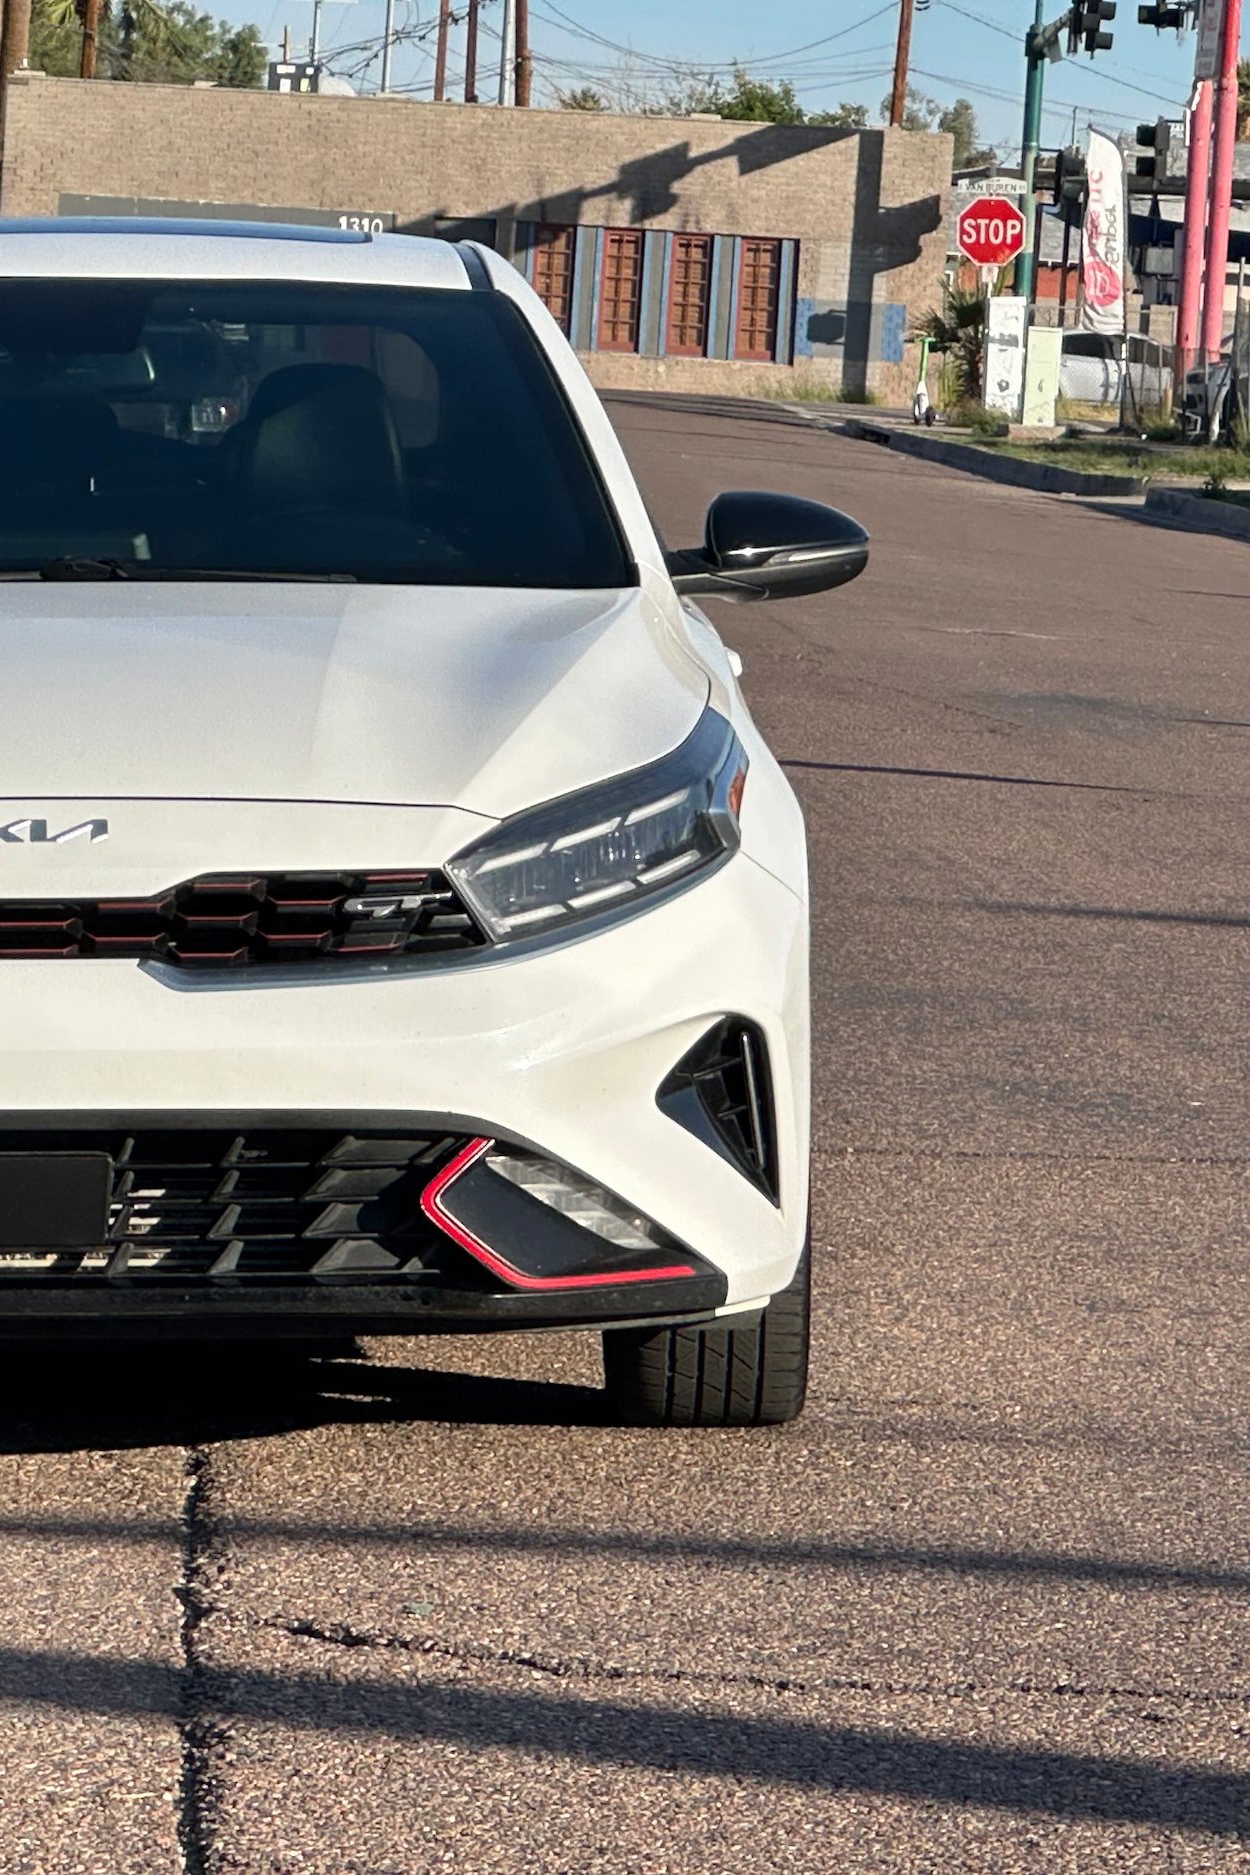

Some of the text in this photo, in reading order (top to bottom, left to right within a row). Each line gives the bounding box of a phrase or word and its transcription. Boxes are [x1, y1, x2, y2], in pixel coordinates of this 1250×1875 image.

[965, 183, 984, 191] VAN
[339, 216, 383, 233] 1310
[962, 218, 1021, 245] STOP
